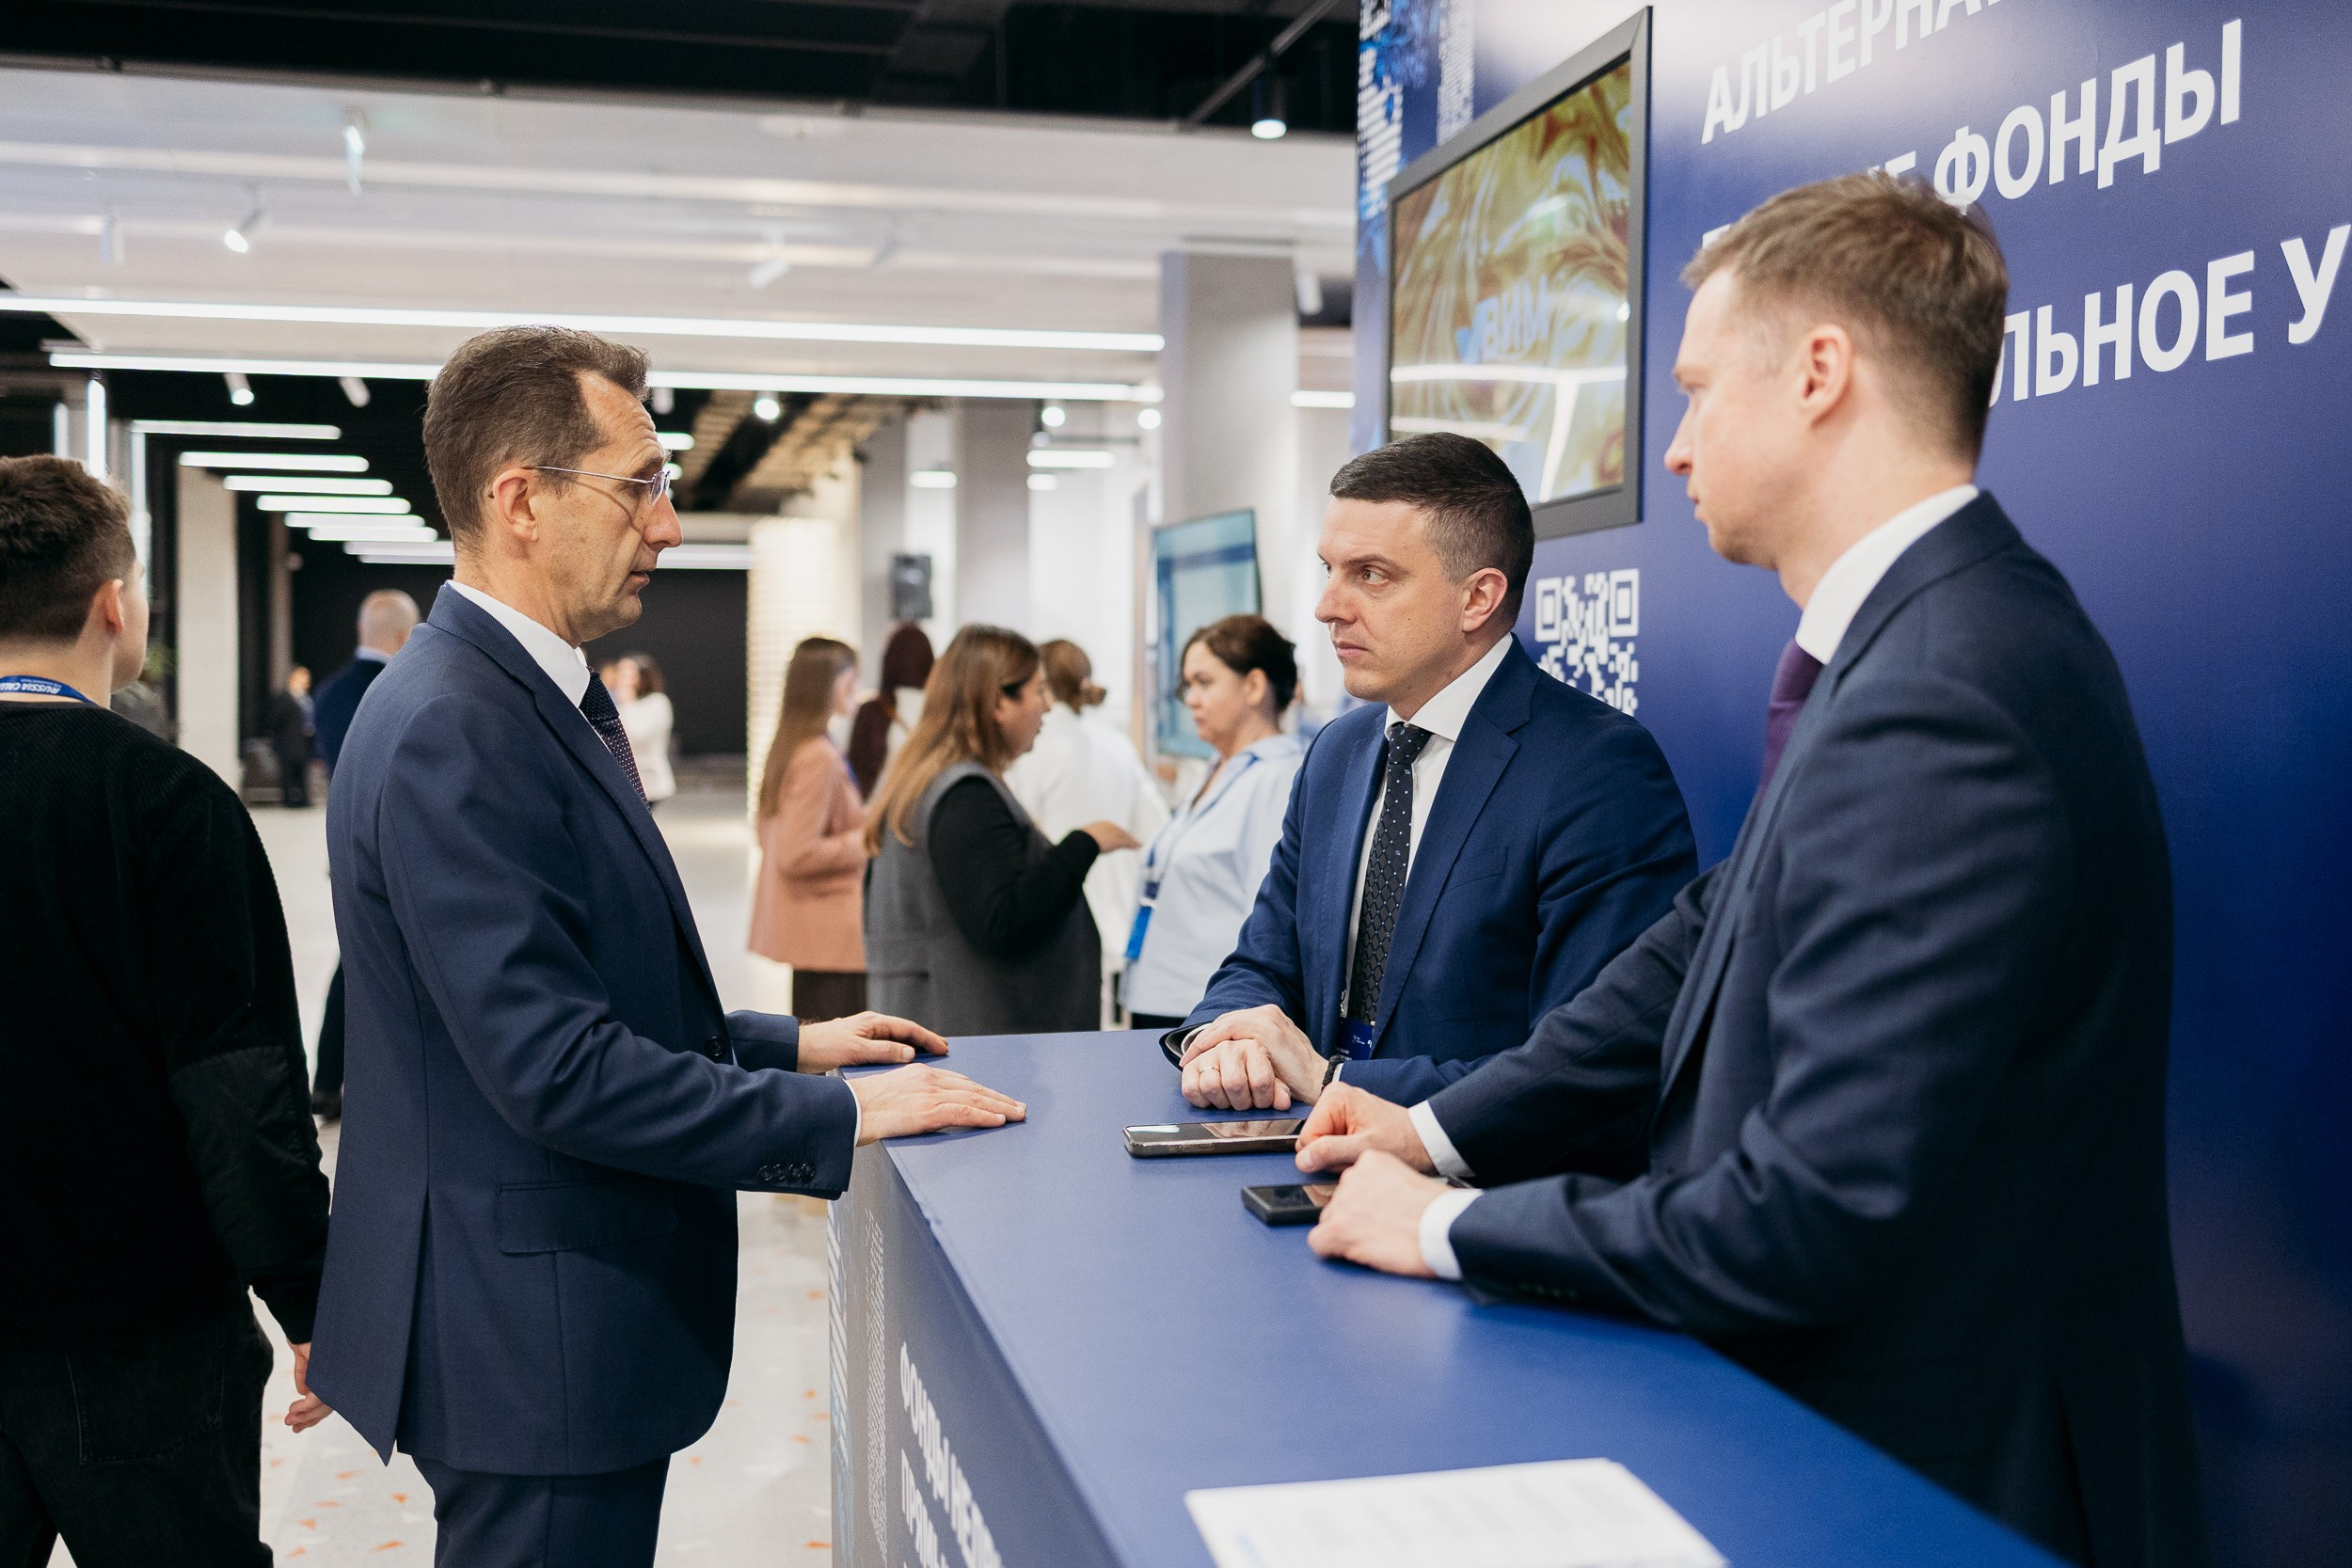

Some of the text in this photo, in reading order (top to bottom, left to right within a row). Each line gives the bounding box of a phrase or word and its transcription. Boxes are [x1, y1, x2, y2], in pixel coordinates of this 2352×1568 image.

[1933, 18, 2242, 215] ФОНДЫ
[1989, 250, 2254, 408] ЛЬНОЕ
[21, 682, 61, 694] RUSSIA
[899, 1340, 949, 1514] ФОНДЫ
